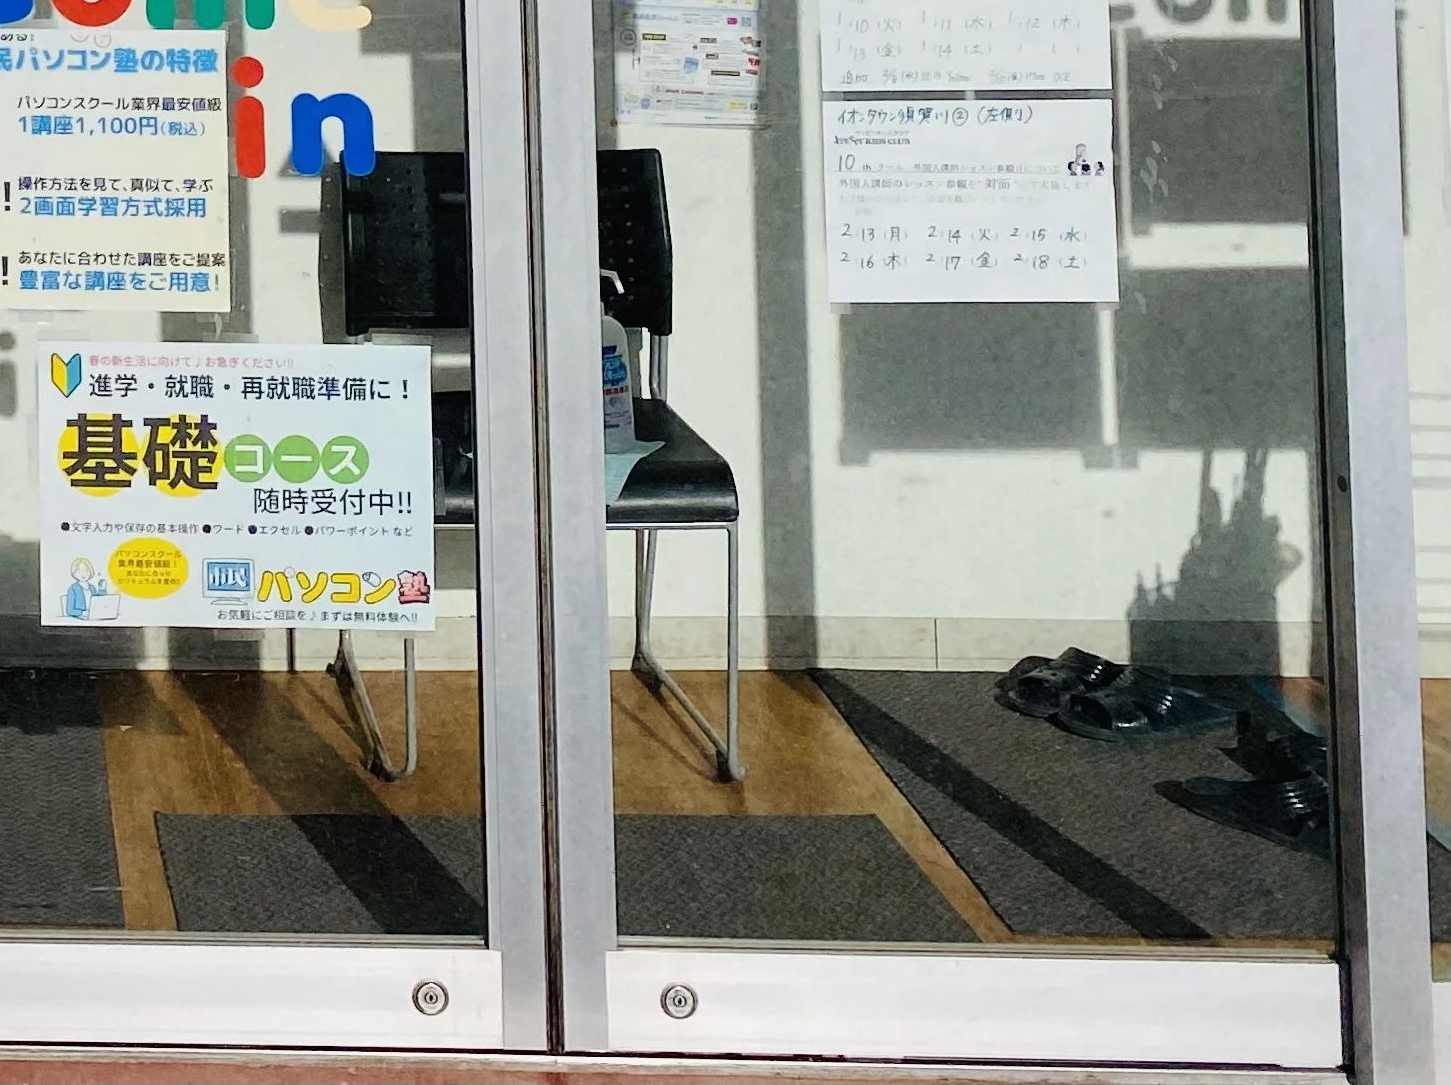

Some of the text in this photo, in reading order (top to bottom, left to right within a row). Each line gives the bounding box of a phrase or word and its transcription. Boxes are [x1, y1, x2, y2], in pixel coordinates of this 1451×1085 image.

[16, 96, 223, 112] パソコンスクール業界最安値級
[19, 114, 206, 138] 1講座1,100円(税込)
[232, 56, 374, 178] in
[18, 176, 214, 193] 操作方法を見て、真似て、学ぶ
[19, 196, 206, 219] 2画面学習方式採用
[18, 250, 226, 268] あなたに合わせた講座をご提案
[19, 269, 220, 293] 豊富な講座をご用意!
[89, 374, 410, 401] 進学・就職・再就職準備に!
[63, 413, 361, 491] 基礎コース
[253, 488, 412, 516] 随時受付中!!
[114, 549, 182, 559] パソコンスクール
[257, 569, 431, 604] パソコン塾
